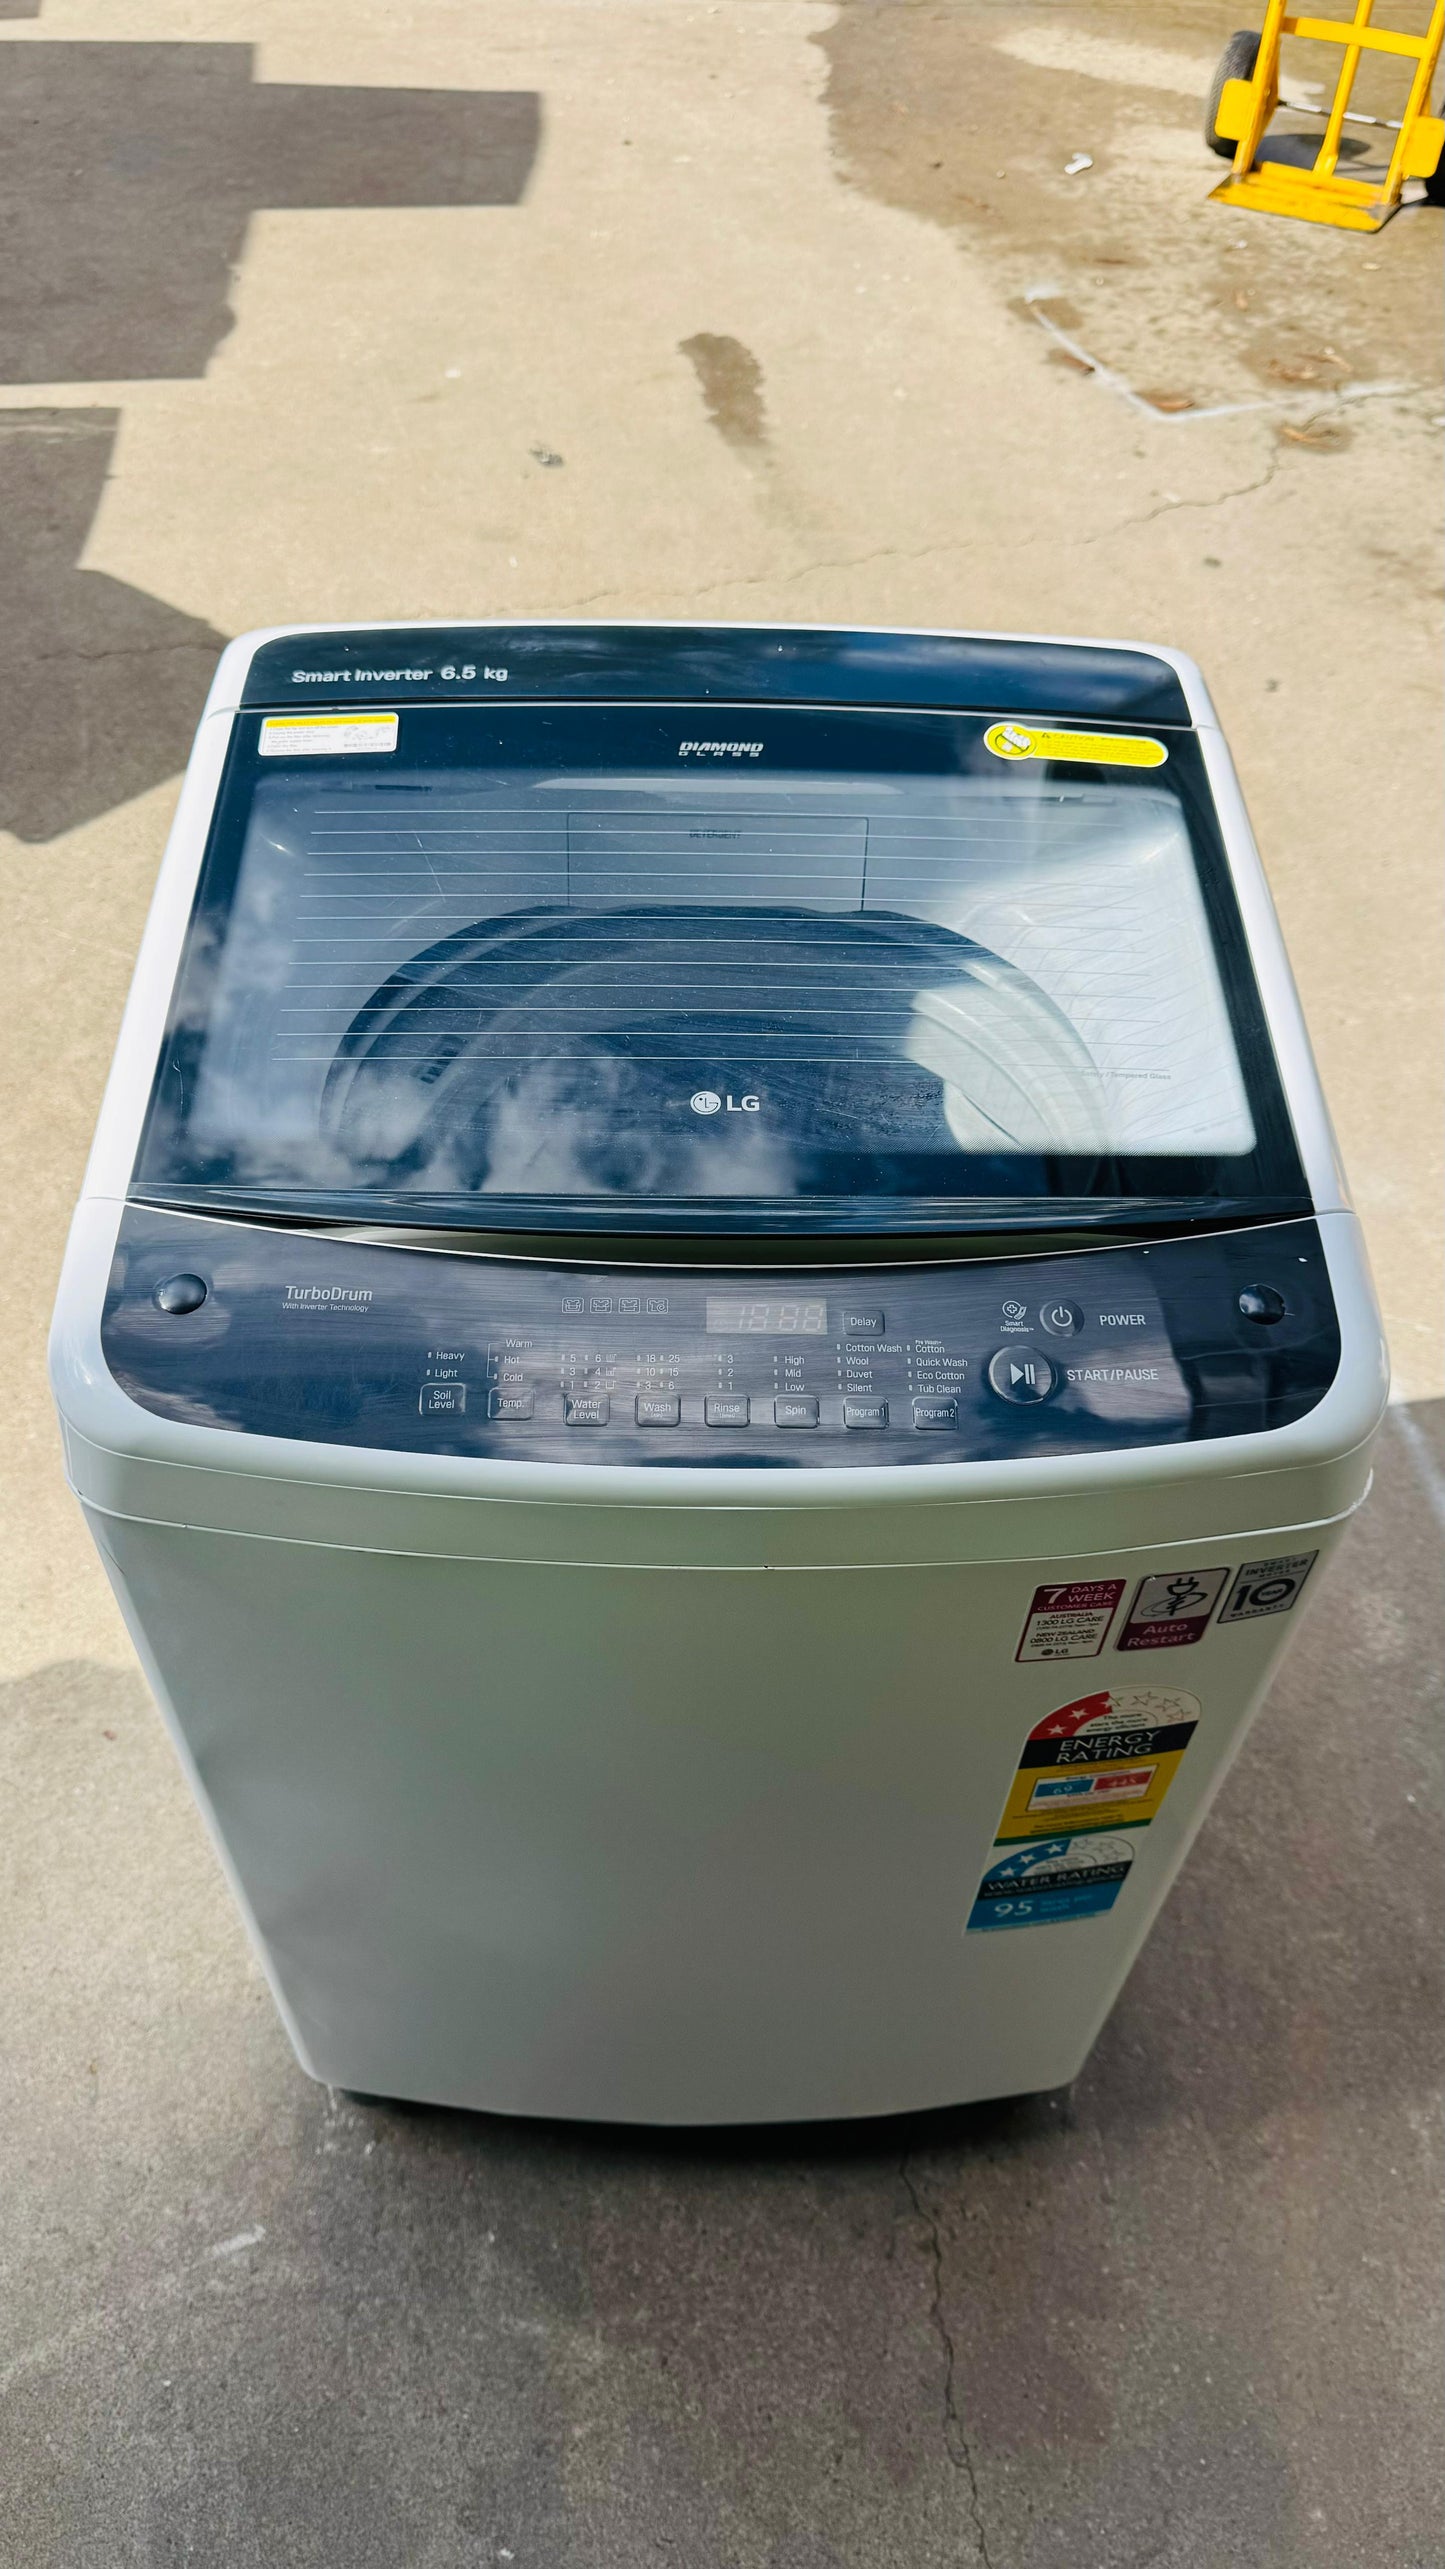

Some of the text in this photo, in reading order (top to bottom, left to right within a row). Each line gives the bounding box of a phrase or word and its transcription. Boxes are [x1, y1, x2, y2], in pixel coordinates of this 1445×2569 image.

[292, 665, 509, 683] Smart Inverter 6.5 kg
[679, 741, 764, 752] DIAMOND
[727, 1095, 760, 1111] LG
[285, 1285, 373, 1301] TurboDrum
[282, 1302, 369, 1312] With Inverter Technology
[850, 1317, 877, 1328] Delay
[1099, 1314, 1147, 1327] POWER
[505, 1338, 533, 1349] Warm
[845, 1343, 902, 1354] Cotton Wash
[915, 1344, 945, 1354] Cotton
[436, 1350, 465, 1362] Heavy
[504, 1355, 520, 1365] Hot
[570, 1353, 602, 1363] 5 6
[646, 1354, 680, 1364] 18 25
[727, 1354, 734, 1365] 3
[784, 1355, 805, 1366] High
[846, 1356, 869, 1367] Wool
[916, 1357, 968, 1368] Quick Wash
[434, 1368, 458, 1379] Light
[503, 1372, 524, 1383] Cold
[569, 1367, 602, 1377] 3 4
[646, 1367, 679, 1377] 10 15
[727, 1367, 734, 1378] 2
[785, 1368, 802, 1379] Mid
[846, 1369, 873, 1380] Duvet
[917, 1370, 966, 1381] Eco Cotton
[1067, 1368, 1159, 1382] START/PAUSE
[570, 1380, 601, 1391] 1 2
[645, 1381, 675, 1391] 3 6
[728, 1381, 733, 1391] 1
[785, 1382, 805, 1393] Low
[847, 1382, 873, 1394] Silent
[917, 1384, 962, 1395] Tub Clean
[433, 1389, 452, 1401] Soil
[428, 1399, 455, 1410] Level
[497, 1396, 525, 1410] Temp.
[571, 1399, 602, 1410] Water
[643, 1402, 672, 1414] Wash
[713, 1403, 741, 1414] Rinse
[573, 1410, 600, 1421] Level
[784, 1404, 807, 1417] Spin
[846, 1407, 878, 1420] Program
[915, 1407, 955, 1420] Program 2
[1244, 1558, 1309, 1577] INVERTER
[1043, 1583, 1118, 1604] 7 DAYS A
[1067, 1591, 1116, 1604] WEEK
[1231, 1578, 1297, 1612] 10
[1049, 1611, 1094, 1620] AUSTRALIA
[1142, 1623, 1189, 1635] Auto
[1127, 1632, 1197, 1647] Restart
[1060, 1730, 1161, 1752] ENERGY
[1056, 1744, 1153, 1763] RATING
[994, 1900, 1034, 1918] 95
